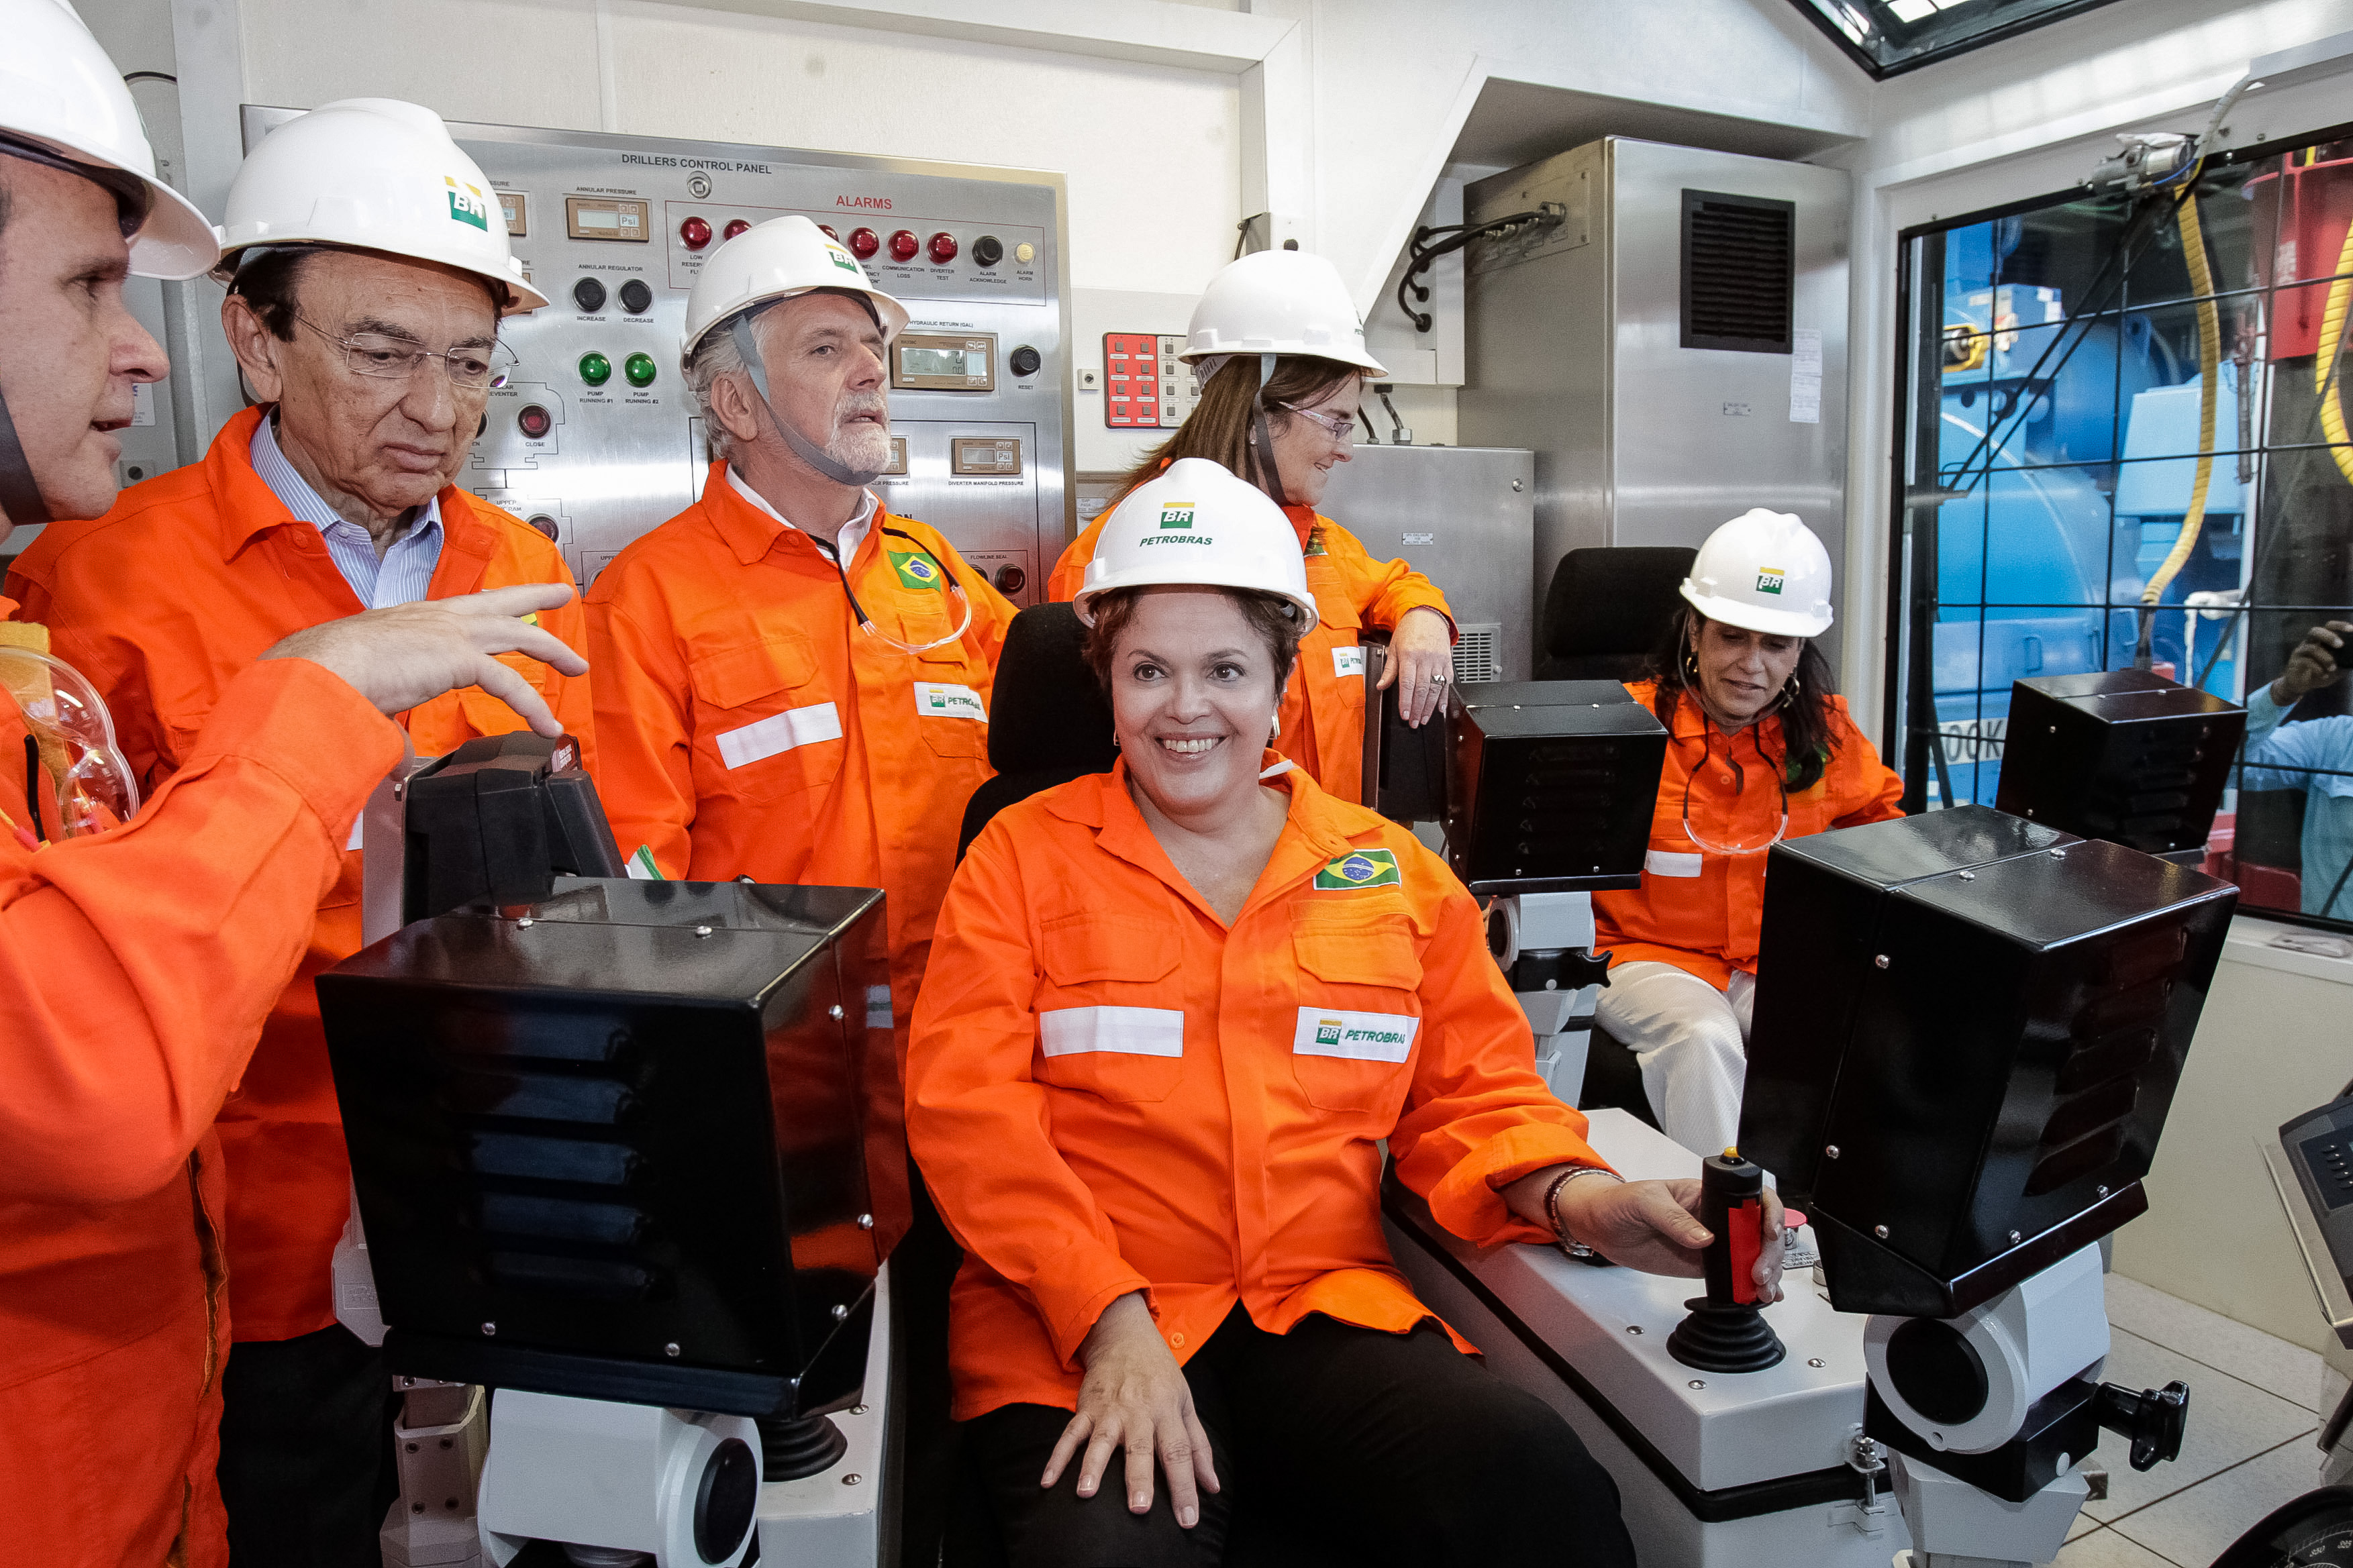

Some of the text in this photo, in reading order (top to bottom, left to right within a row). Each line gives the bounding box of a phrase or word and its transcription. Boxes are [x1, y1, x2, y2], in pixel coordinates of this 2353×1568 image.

[621, 154, 772, 174] DRILLERS CONTROL PANEL
[605, 187, 637, 195] PRESSURE
[454, 194, 485, 219] BR
[836, 195, 893, 209] ALARMS
[832, 252, 855, 268] BR
[578, 263, 643, 272] ANNULAR REGULATOR
[1163, 511, 1191, 522] BR
[1139, 535, 1213, 547] PETROBRAS
[1760, 576, 1782, 589] BR
[1319, 1027, 1406, 1045] BR PETROBRAS
